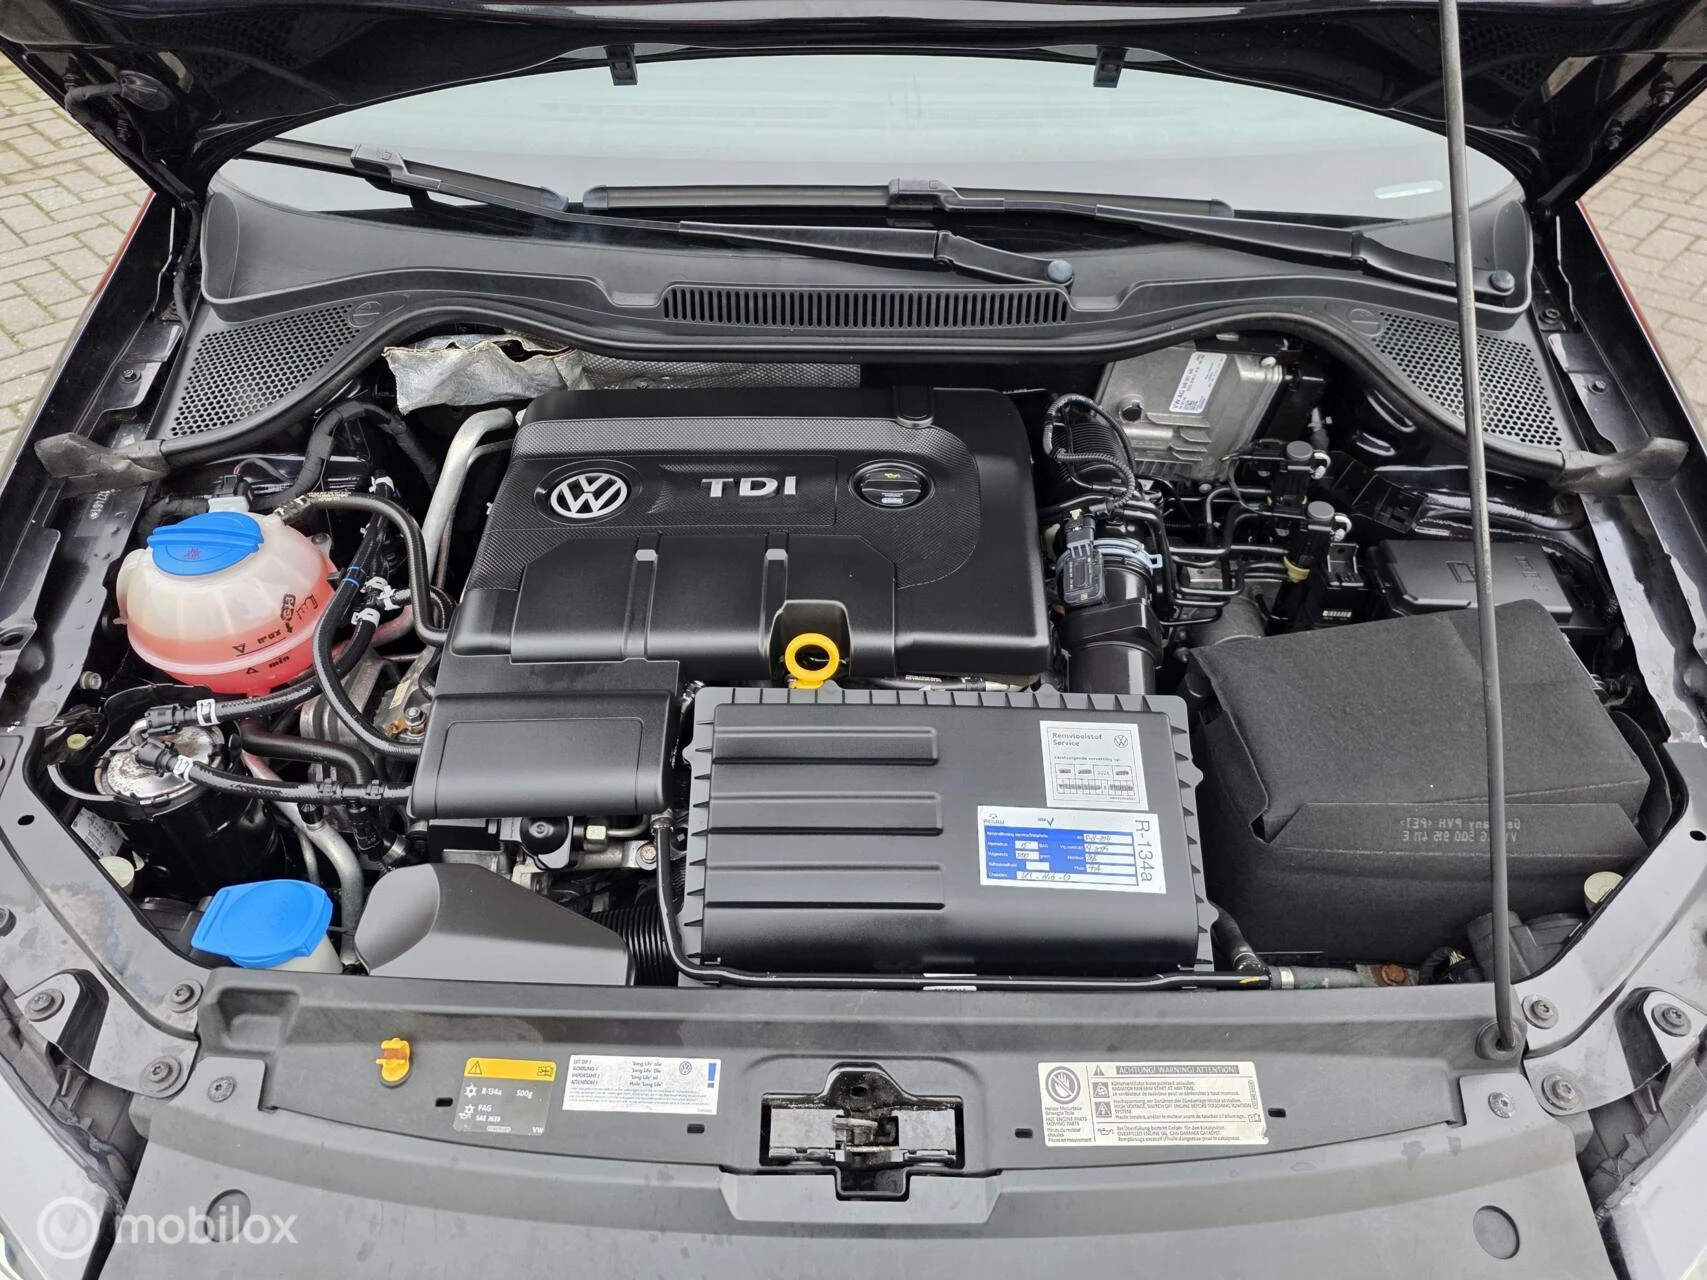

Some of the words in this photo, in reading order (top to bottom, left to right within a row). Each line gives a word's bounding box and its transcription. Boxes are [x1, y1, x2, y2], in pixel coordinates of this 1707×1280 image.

[701, 476, 797, 498] TDI
[257, 629, 281, 644] max
[268, 655, 290, 668] min
[1134, 820, 1155, 881] R-134a
[516, 1090, 533, 1099] 500g
[532, 1126, 544, 1134] VW
